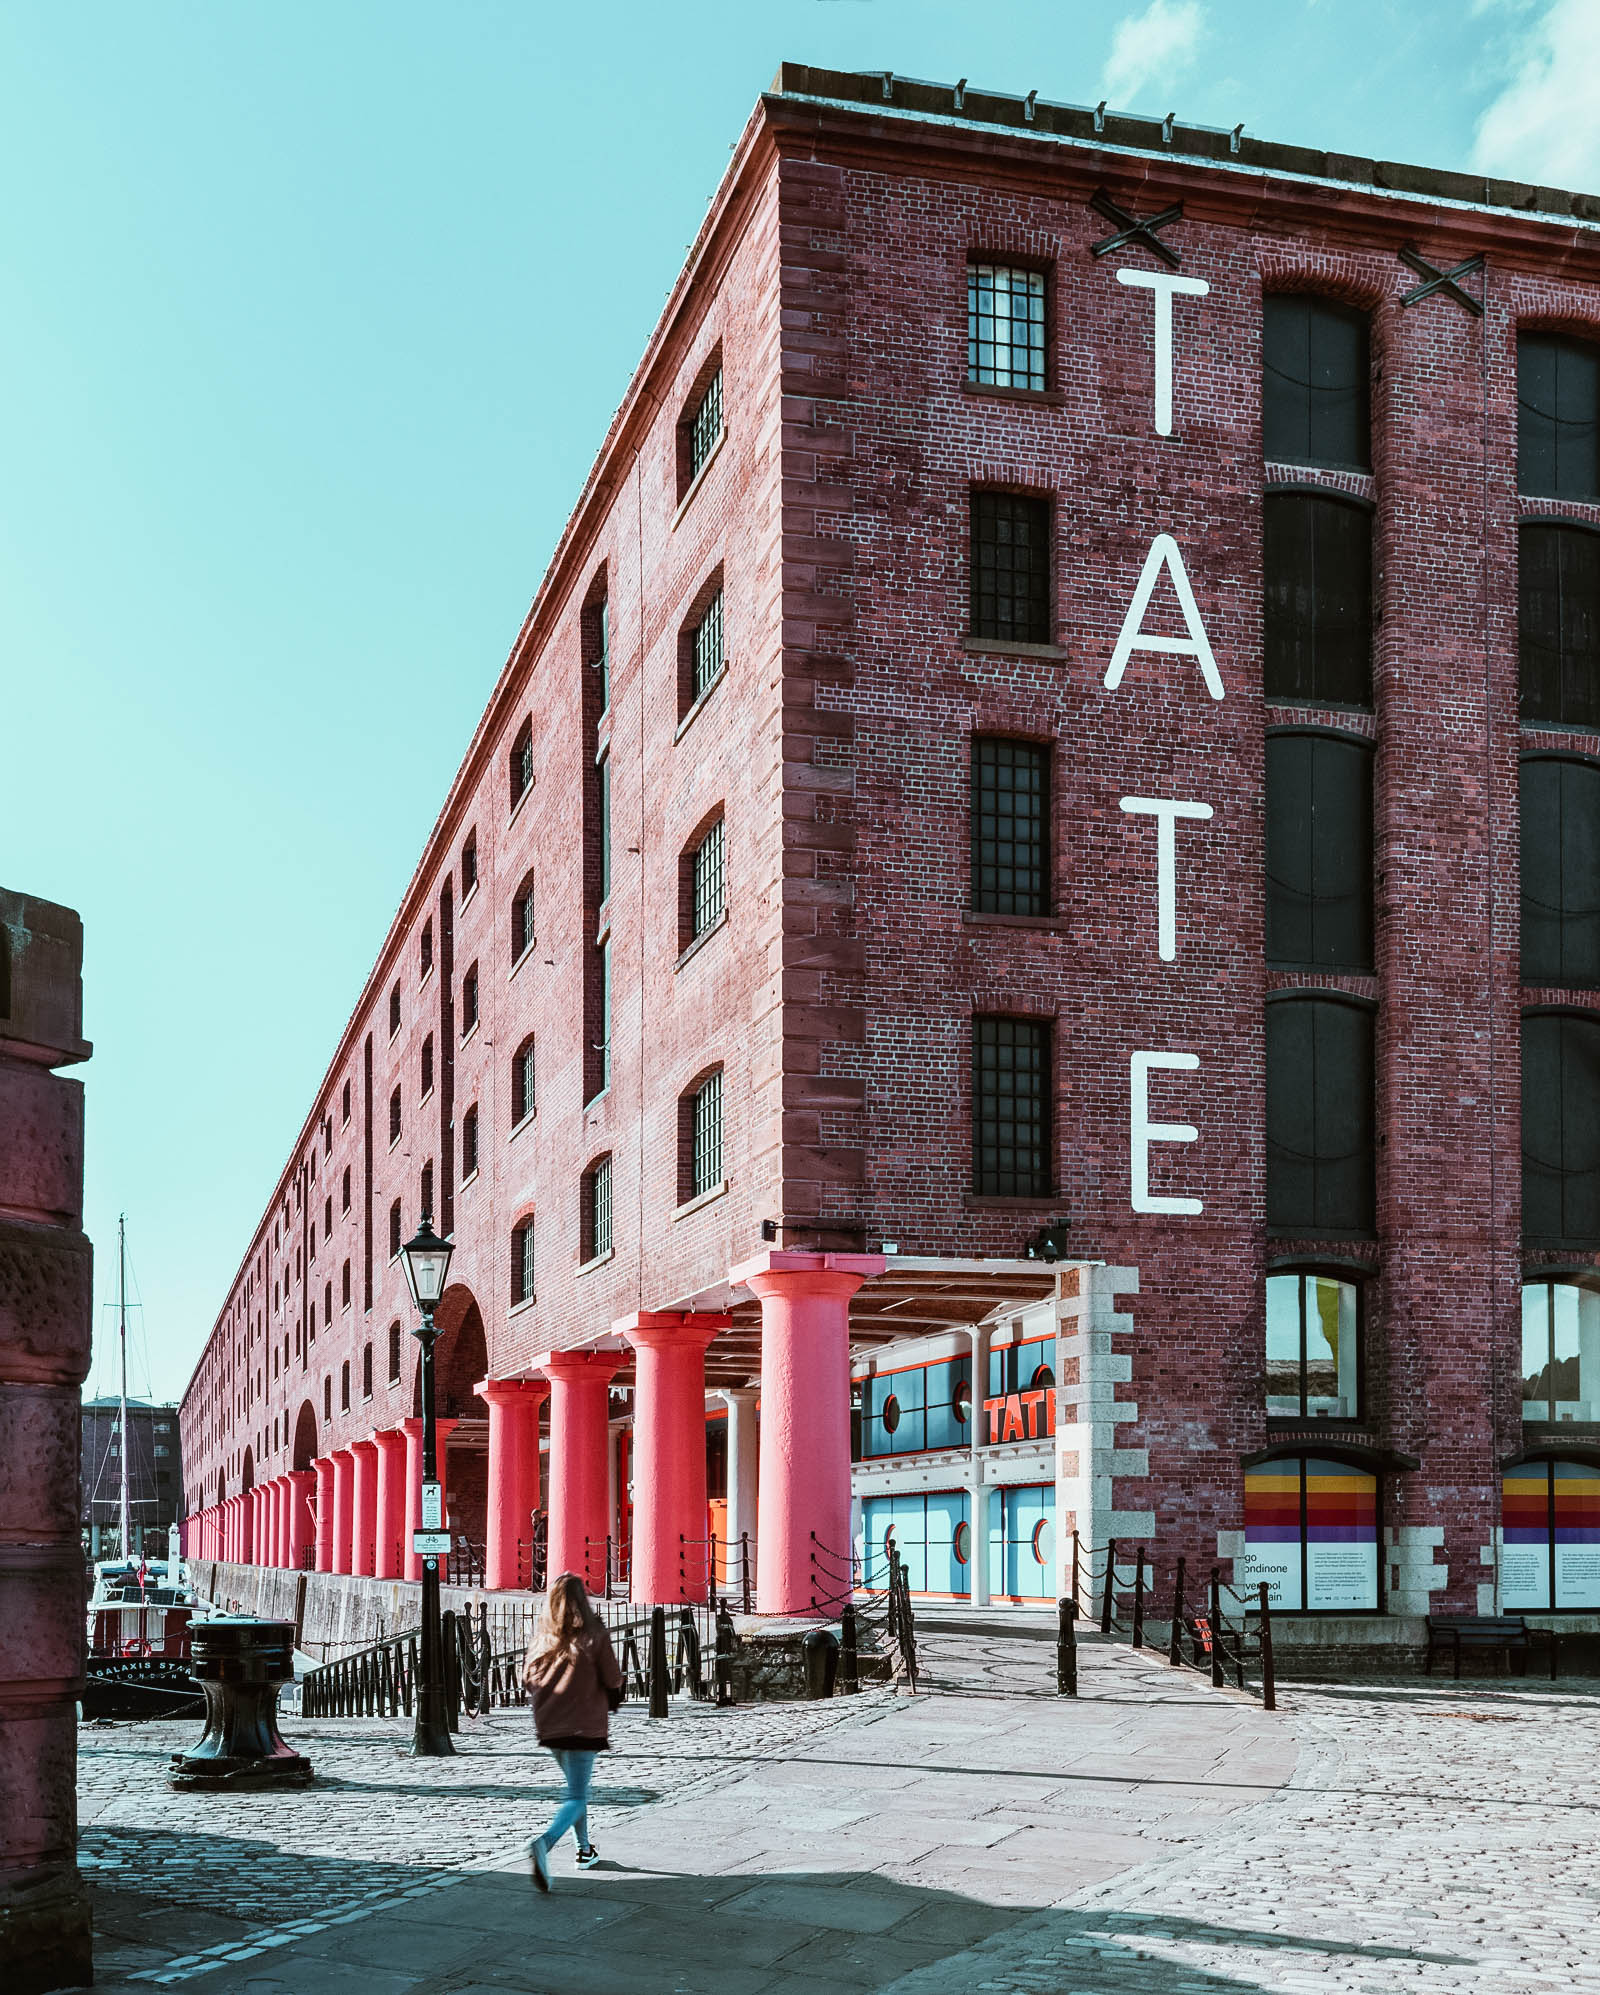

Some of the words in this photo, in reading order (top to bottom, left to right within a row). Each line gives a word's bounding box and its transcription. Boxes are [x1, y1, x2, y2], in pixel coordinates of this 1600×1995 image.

[1104, 268, 1225, 1214] TATE
[1245, 1554, 1257, 1564] go
[1245, 1563, 1288, 1573] ondinone
[96, 1662, 151, 1677] GALAXIS
[160, 1662, 192, 1676] STAR
